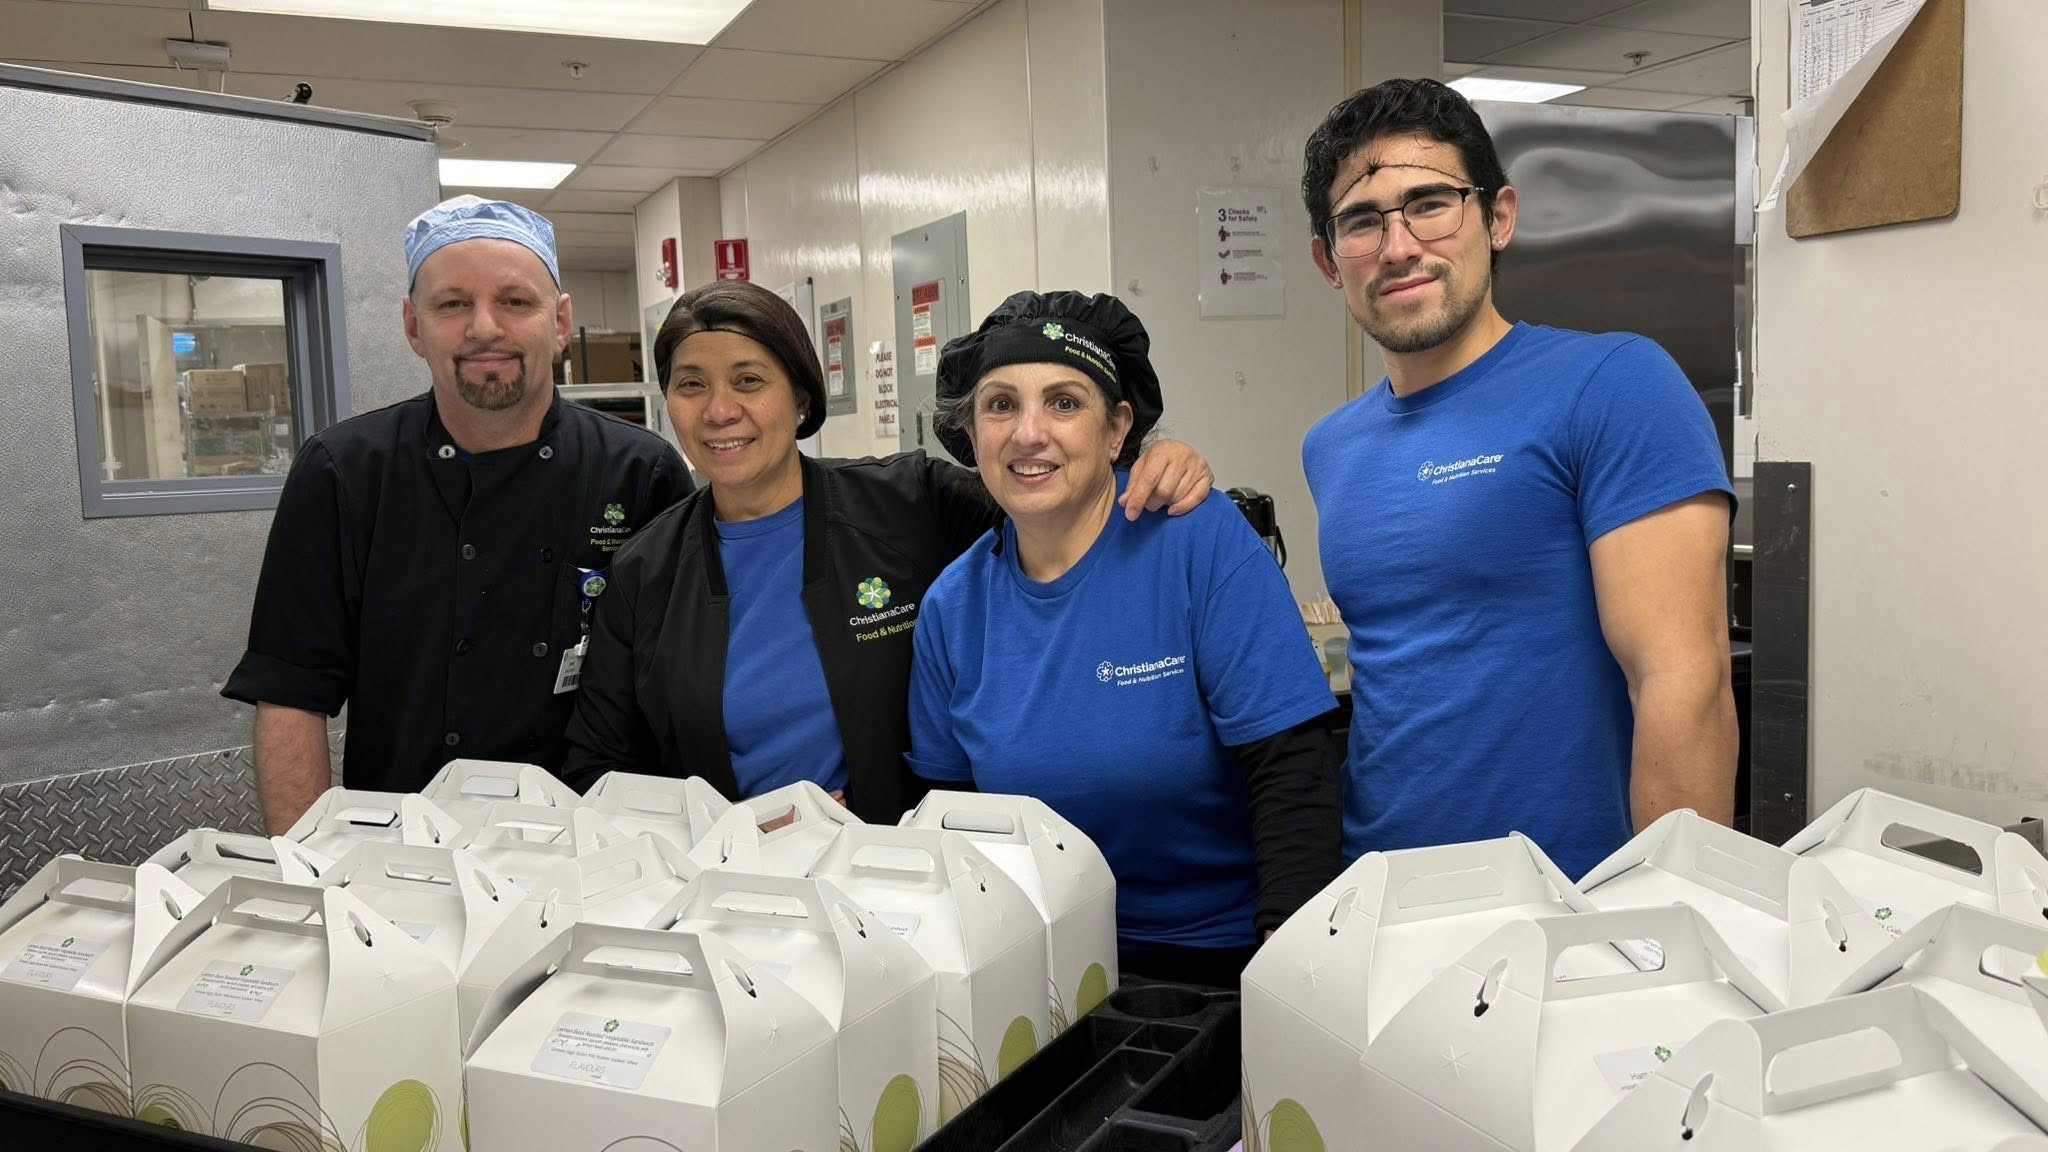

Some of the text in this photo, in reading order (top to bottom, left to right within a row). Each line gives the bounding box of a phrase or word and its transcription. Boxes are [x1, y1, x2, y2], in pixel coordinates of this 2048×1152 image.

[1218, 208, 1227, 222] 3
[875, 352, 893, 363] PLEASE
[875, 368, 893, 378] DO NOT
[878, 383, 894, 394] BLOCK
[875, 399, 899, 409] ELECTRICAL
[878, 414, 895, 424] PANELS
[1470, 467, 1496, 476] Services
[849, 603, 915, 626] ChristianaCare
[856, 630, 879, 642] Food
[879, 627, 888, 637] &
[1629, 1071, 1649, 1081] Ham
